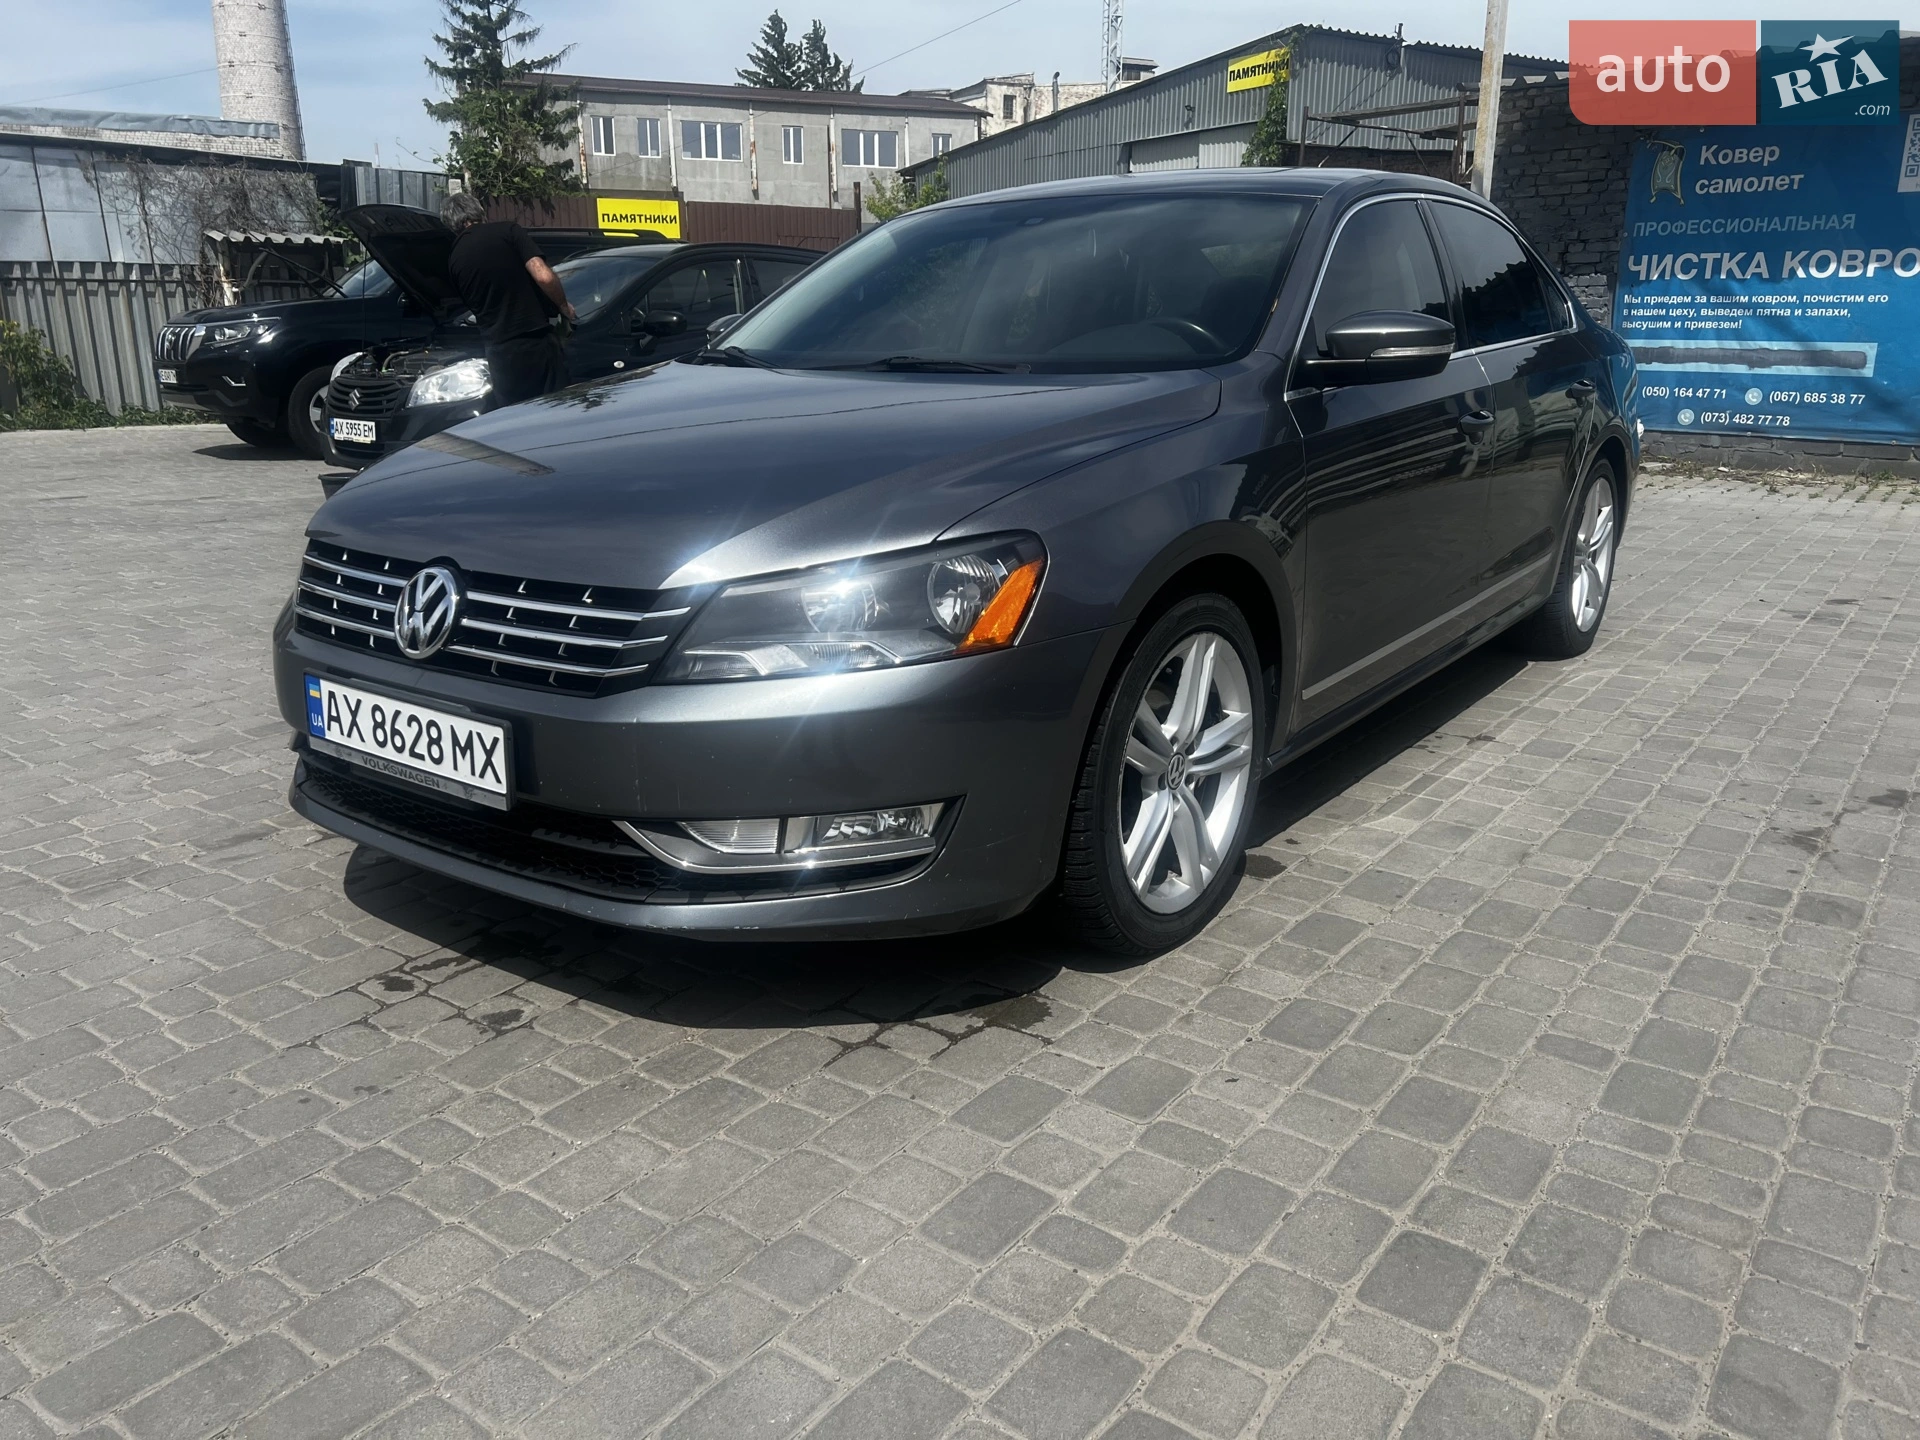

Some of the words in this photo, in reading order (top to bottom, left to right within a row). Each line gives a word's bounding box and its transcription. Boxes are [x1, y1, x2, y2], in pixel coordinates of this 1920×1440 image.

[1700, 144, 1781, 167] Ковер
[1695, 172, 1805, 195] самолет
[602, 213, 678, 224] ПАМЯТНИКИ
[1633, 213, 1856, 237] ПРОФЕССИОНАЛЬНАЯ
[1627, 251, 1770, 281] ЧИСТКА
[1781, 247, 1920, 279] КОВРО
[1624, 294, 1641, 304] Мы
[1643, 294, 1692, 306] приедем
[1694, 295, 1707, 303] за
[1710, 294, 1749, 303] вашим
[1751, 294, 1800, 305] ковром,
[1803, 294, 1865, 303] почистим
[1867, 294, 1889, 303] его
[1631, 307, 1666, 316] нашем
[1669, 308, 1697, 318] цеху,
[1700, 308, 1753, 317] выведем
[1756, 308, 1791, 317] пятна
[1794, 308, 1802, 317] и
[1804, 308, 1851, 318] запахи,
[1622, 320, 1671, 331] высушим
[1674, 320, 1681, 329] и
[1684, 319, 1743, 331] привезем!
[1642, 386, 1670, 399] (050)
[1673, 387, 1693, 398] 164
[1696, 388, 1711, 398] 47
[1713, 388, 1727, 399] 71
[1769, 390, 1800, 405] (067)
[1803, 392, 1827, 403] 685
[1830, 393, 1846, 404] 38
[1849, 394, 1866, 405] 77
[1700, 411, 1730, 426] (073)
[1732, 413, 1754, 425] 482
[1757, 414, 1773, 425] 77
[1776, 415, 1791, 427] 78
[335, 420, 345, 435] AX
[345, 421, 362, 437] 5955
[363, 423, 374, 438] EM
[311, 712, 324, 729] UA
[327, 690, 366, 743] AX
[371, 703, 445, 766] 8628
[450, 724, 503, 784] MX
[361, 755, 441, 789] VOLKSWAGEN
